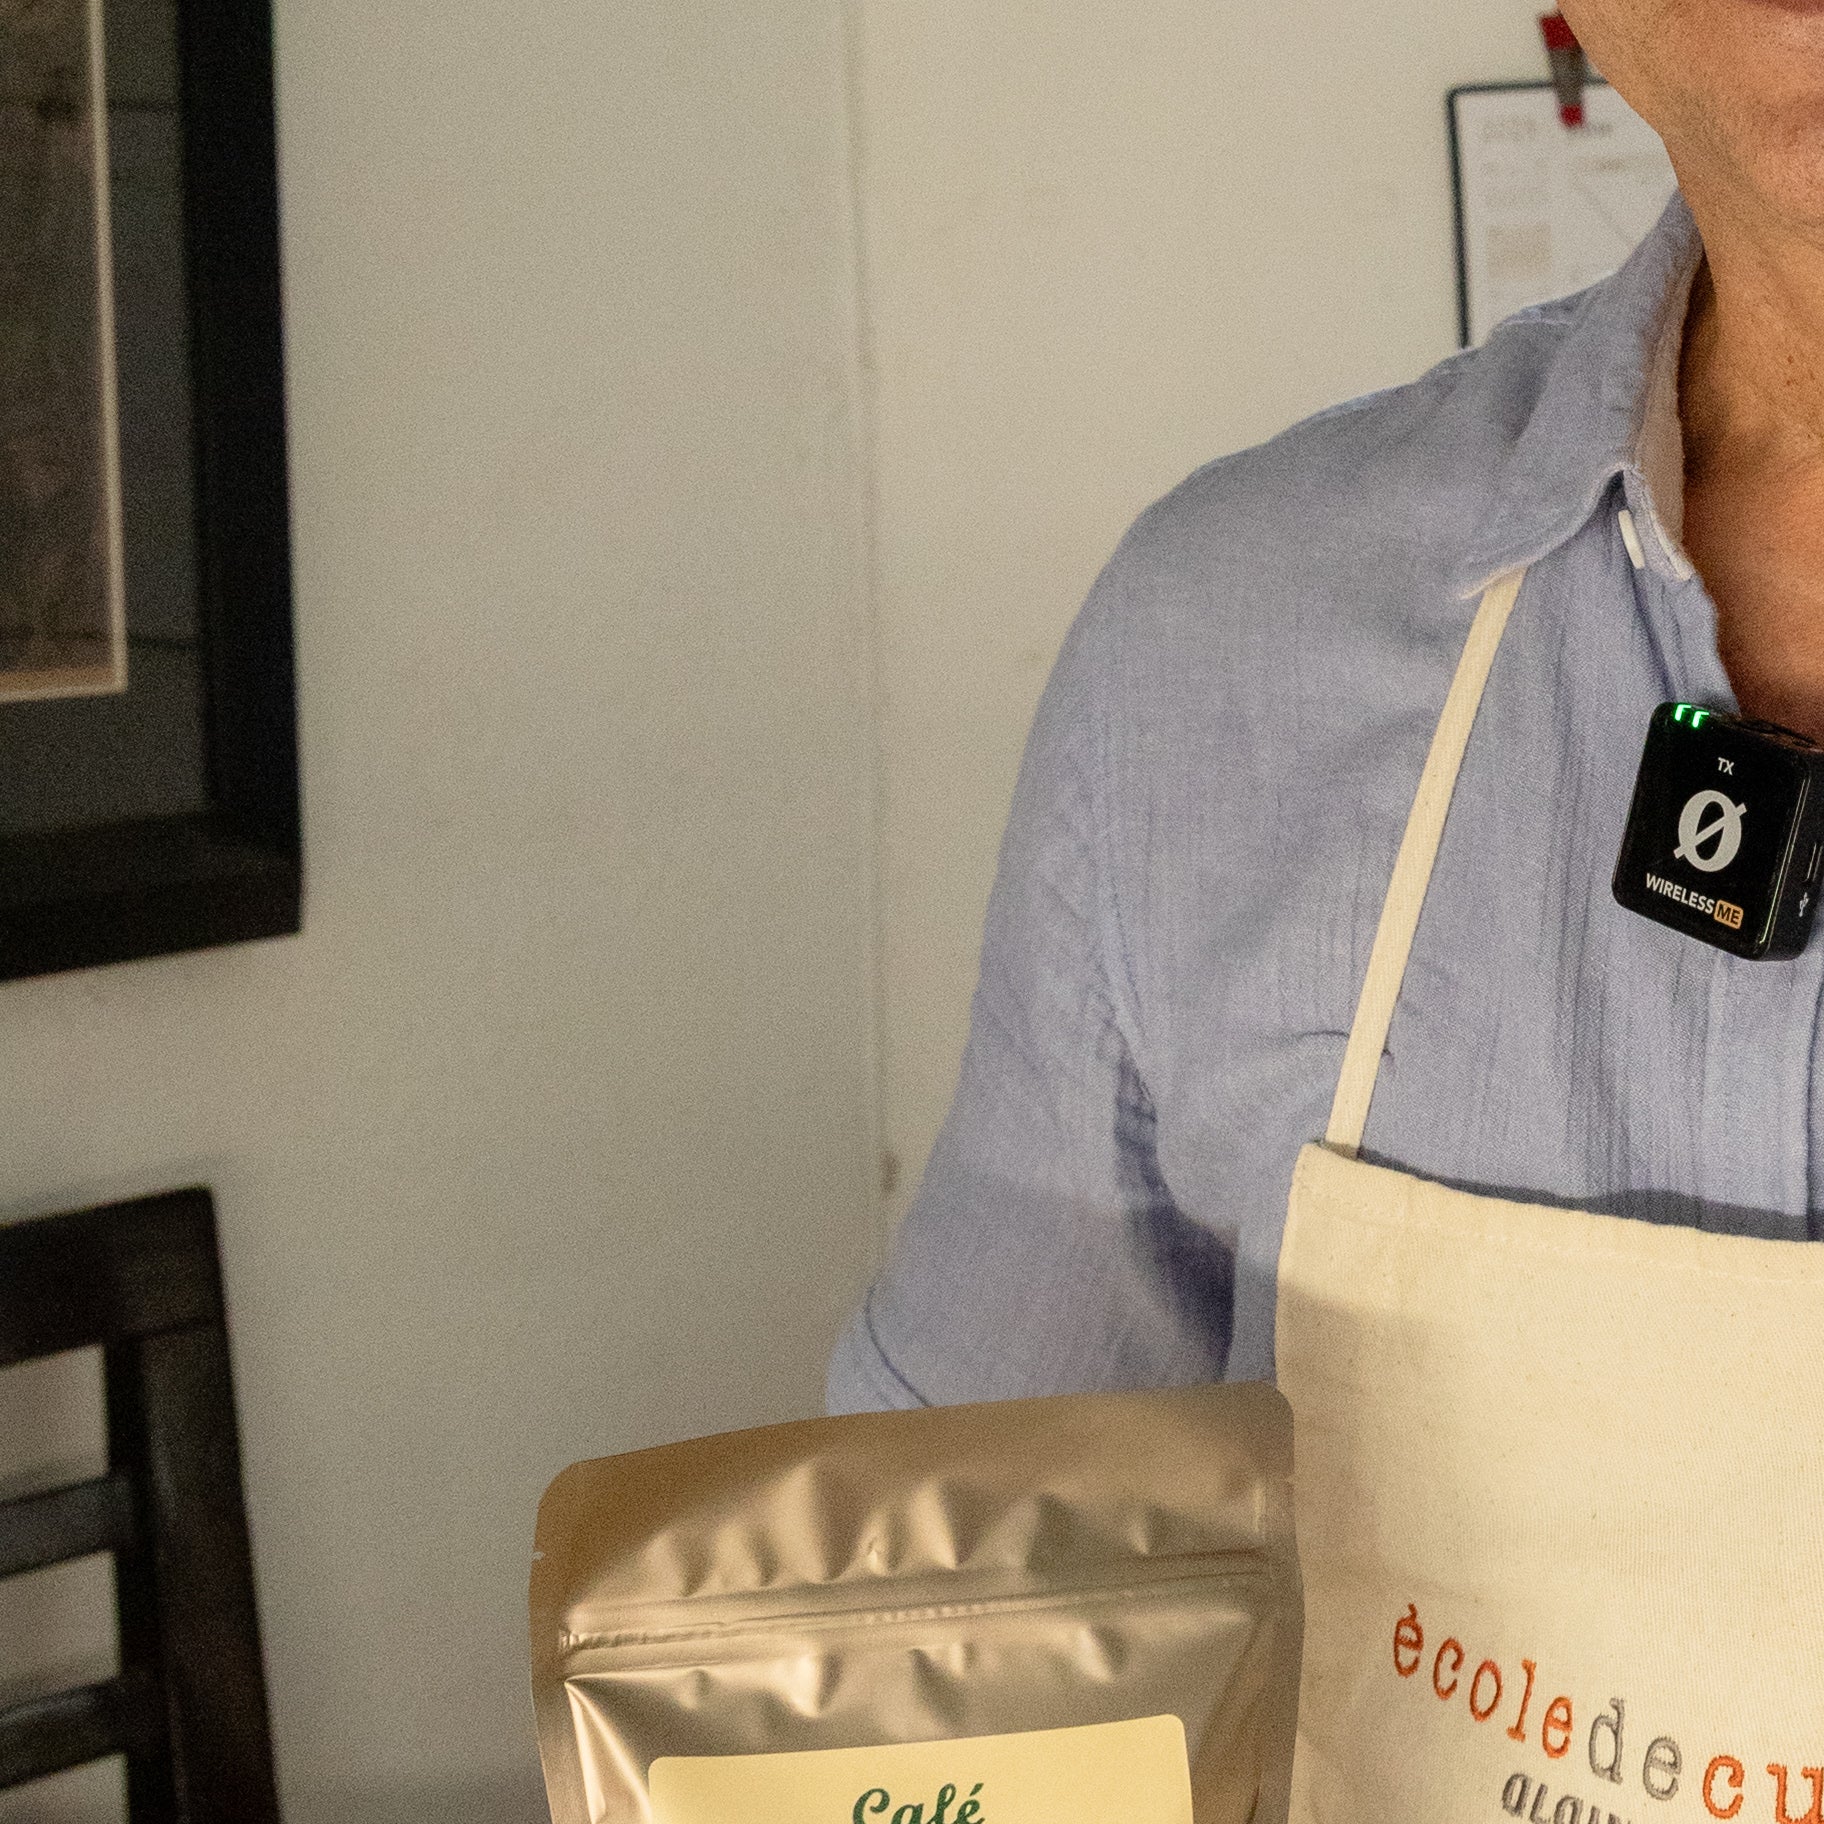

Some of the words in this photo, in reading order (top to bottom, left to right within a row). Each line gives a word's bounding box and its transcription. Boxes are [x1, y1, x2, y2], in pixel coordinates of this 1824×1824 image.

[1717, 757, 1735, 775] TX
[1645, 872, 1715, 915] WIRELESS
[1716, 903, 1741, 925] ME
